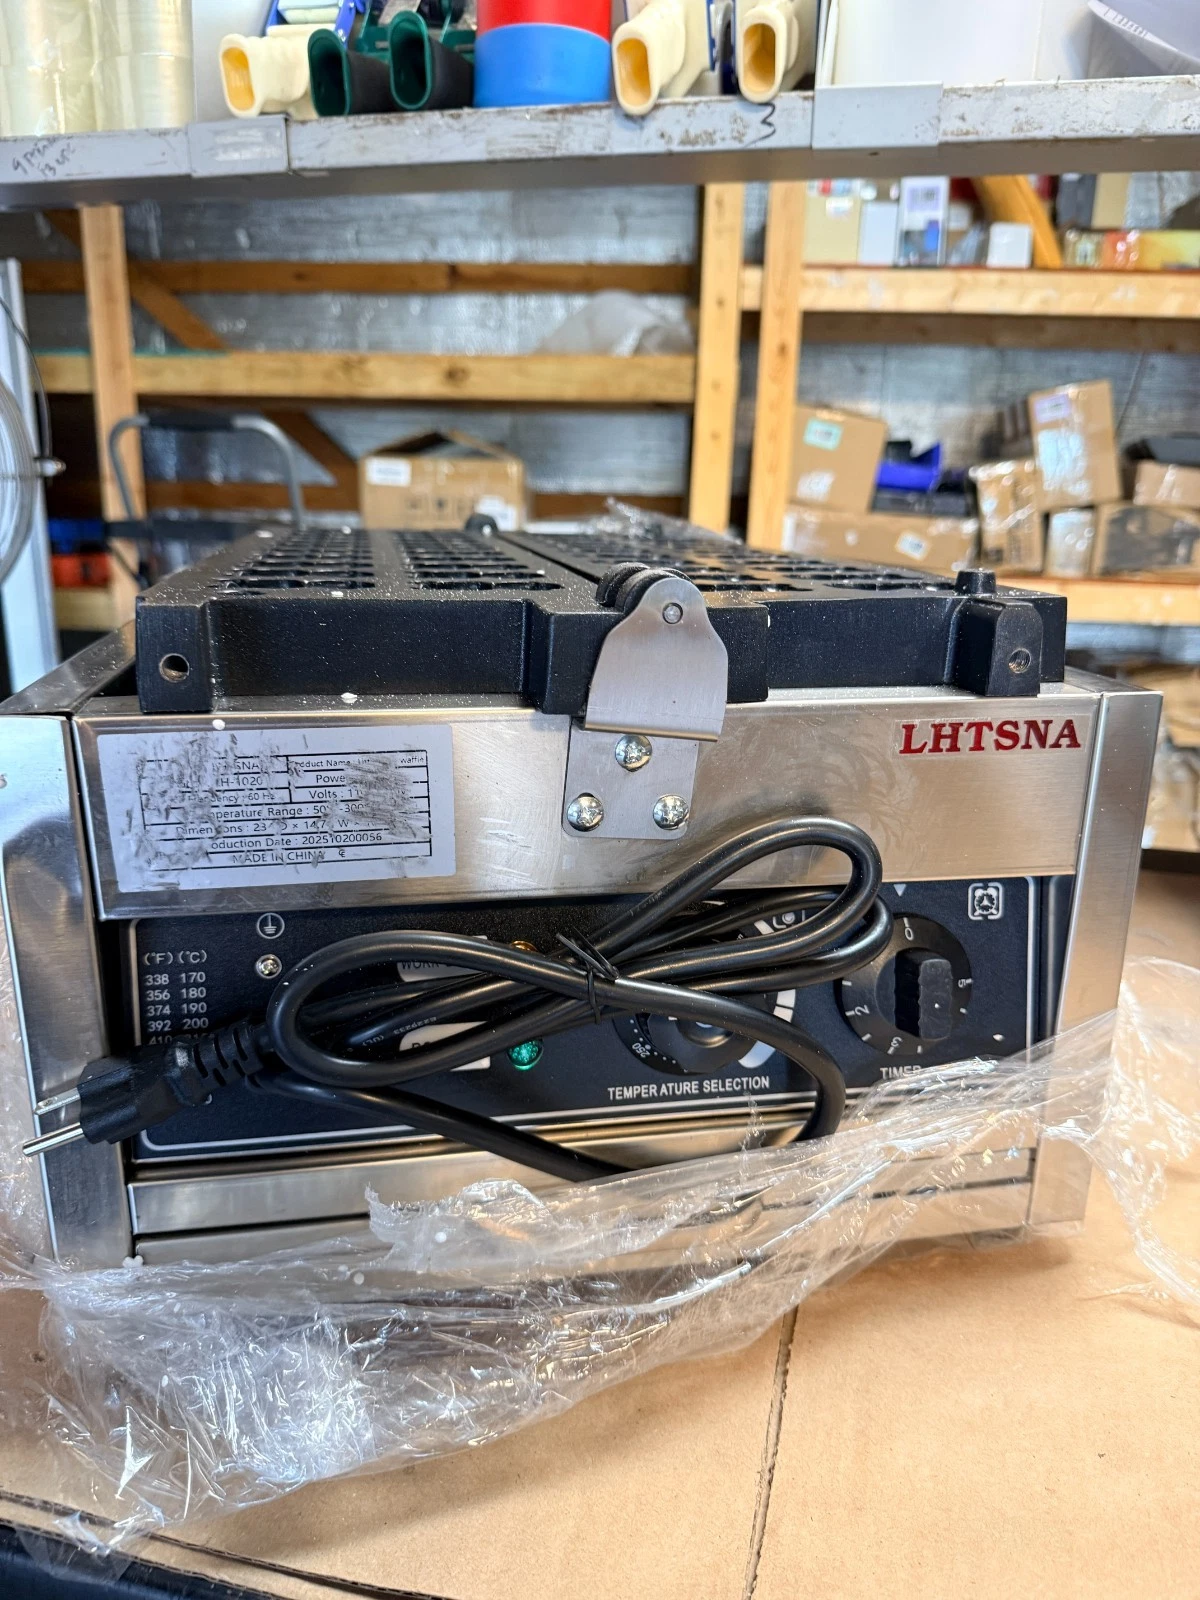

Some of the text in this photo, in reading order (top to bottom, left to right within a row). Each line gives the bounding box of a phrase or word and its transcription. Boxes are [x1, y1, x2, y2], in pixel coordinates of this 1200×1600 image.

[899, 719, 1081, 755] LHTSNA
[316, 773, 346, 784] Powe
[309, 789, 337, 799] Volts
[268, 806, 302, 818] Range
[211, 837, 262, 850] oduction
[265, 836, 292, 847] Date
[272, 852, 284, 862] IN
[145, 971, 206, 986] 338 170
[146, 986, 207, 1001] 356 180
[147, 1001, 207, 1017] 374 190
[854, 1004, 870, 1016] 2
[147, 1017, 209, 1032] 392 200
[890, 1036, 902, 1048] 3
[632, 1042, 650, 1058] 250
[607, 1076, 771, 1101] TEMPERATURE SELECTION
